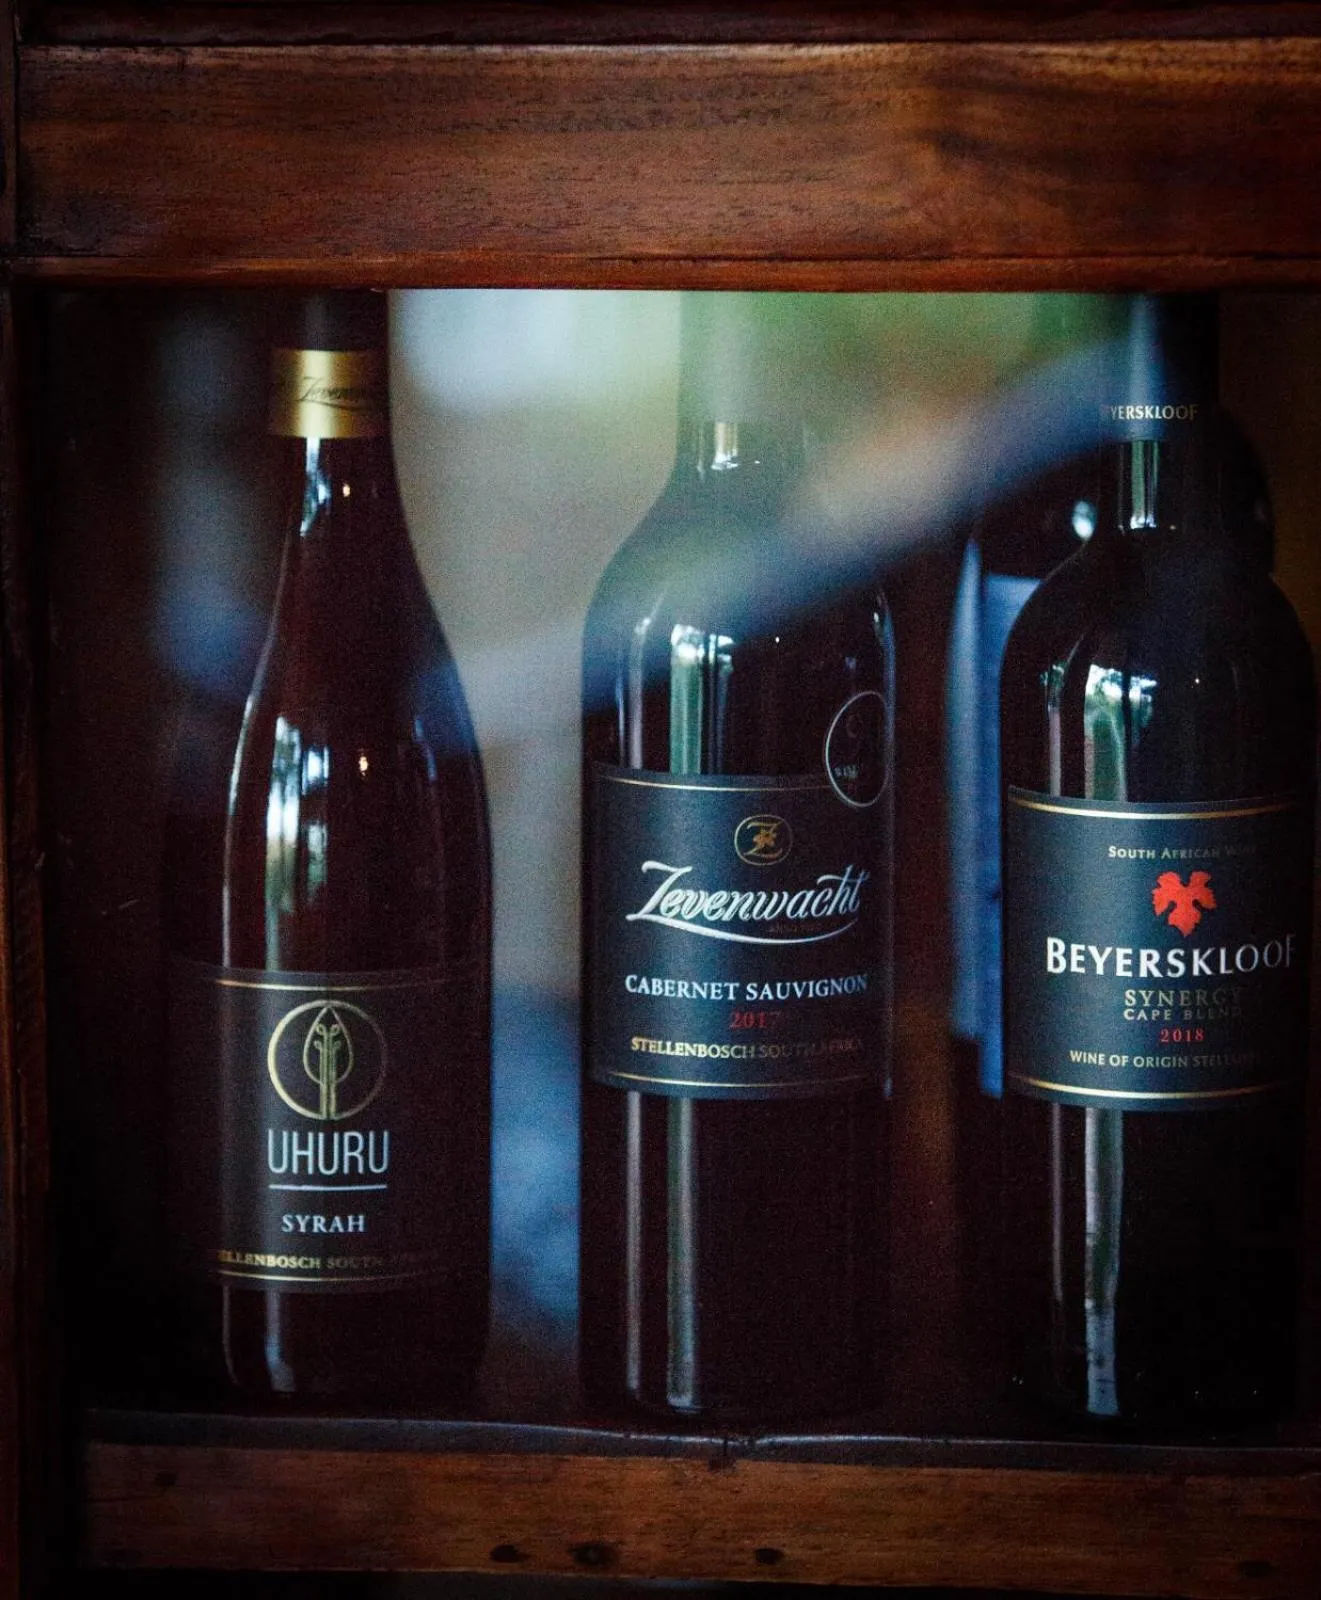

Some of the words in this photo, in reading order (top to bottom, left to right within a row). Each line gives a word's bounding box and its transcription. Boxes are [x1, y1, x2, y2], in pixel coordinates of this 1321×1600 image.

[1108, 846, 1156, 859] SOUTH
[625, 860, 871, 944] Zevenwacht
[1046, 933, 1296, 978] BEYERSKLOOF
[625, 973, 740, 1001] CABERNET
[746, 973, 869, 1001] SAUVIGNON
[1124, 986, 1241, 1008] SYNERGY
[1122, 1007, 1173, 1021] CAPE
[1160, 1028, 1205, 1043] 2018
[630, 1035, 755, 1060] STELLENBOSCH
[1069, 1050, 1105, 1066] WINE
[1109, 1054, 1130, 1068] OF
[1132, 1055, 1188, 1069] ORIGIN
[267, 1128, 390, 1176] UHURU
[281, 1213, 367, 1234] SYRAH
